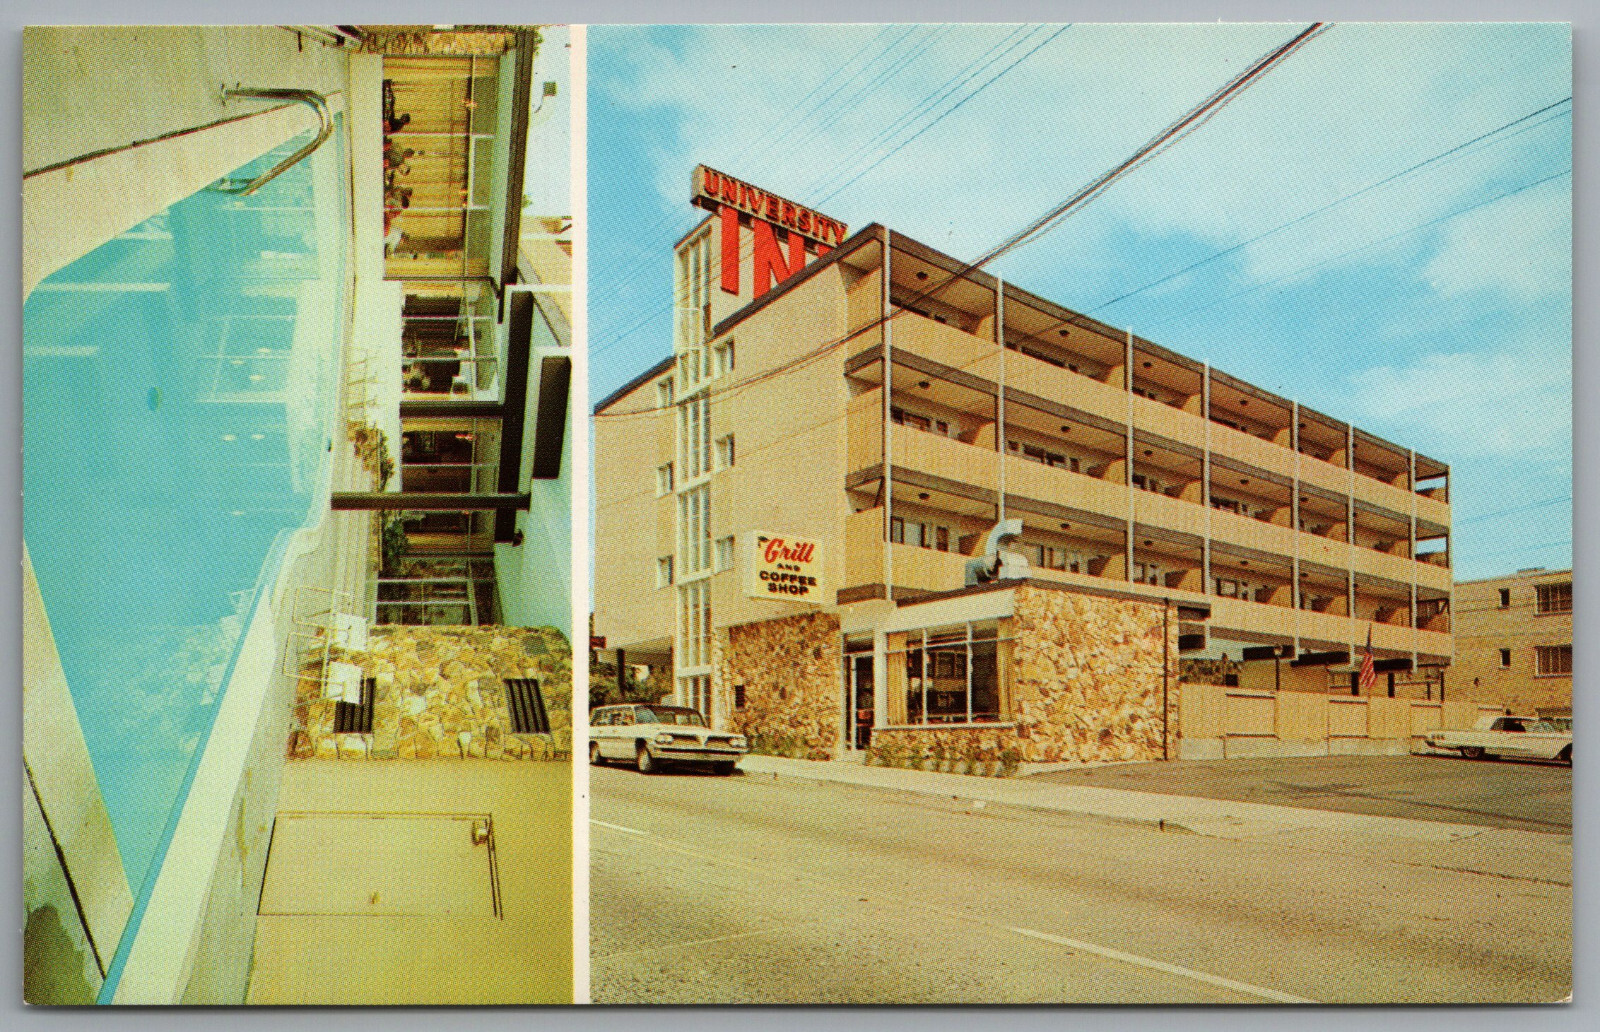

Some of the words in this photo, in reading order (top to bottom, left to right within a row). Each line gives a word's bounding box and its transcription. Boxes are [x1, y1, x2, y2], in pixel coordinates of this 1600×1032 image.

[704, 168, 847, 245] UNIVERSITY
[720, 205, 833, 299] IN
[764, 538, 815, 563] Grill
[759, 570, 817, 586] COFFEE
[767, 582, 809, 595] SHOP
